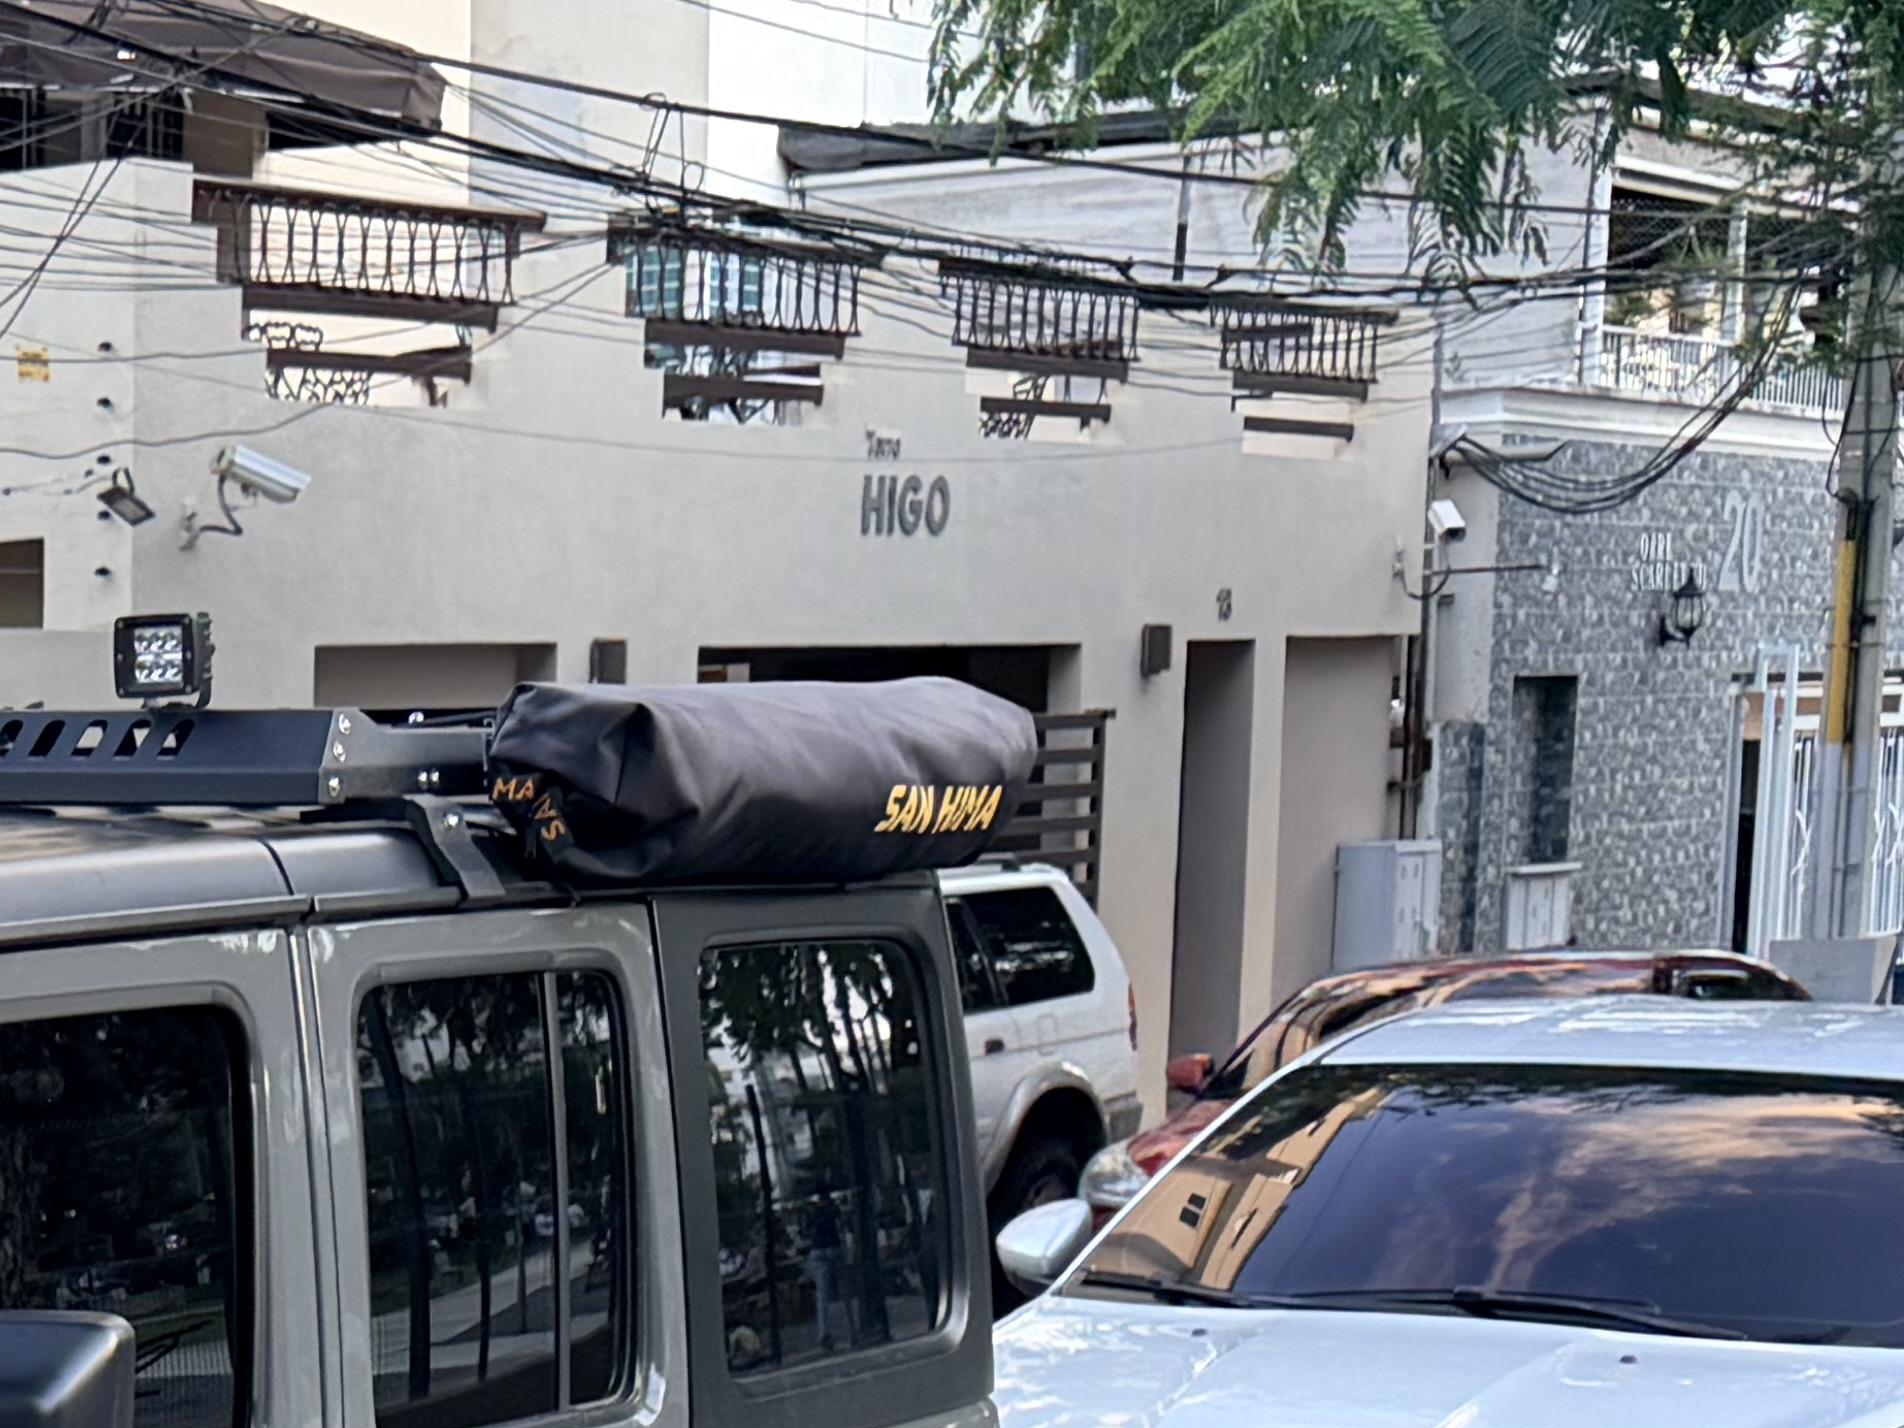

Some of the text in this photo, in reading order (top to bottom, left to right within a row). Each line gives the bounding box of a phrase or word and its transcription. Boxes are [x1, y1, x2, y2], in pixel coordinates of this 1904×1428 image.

[861, 475, 950, 537] HIGO
[1719, 489, 1765, 593] 20
[874, 784, 1003, 834] SAN HIMA
